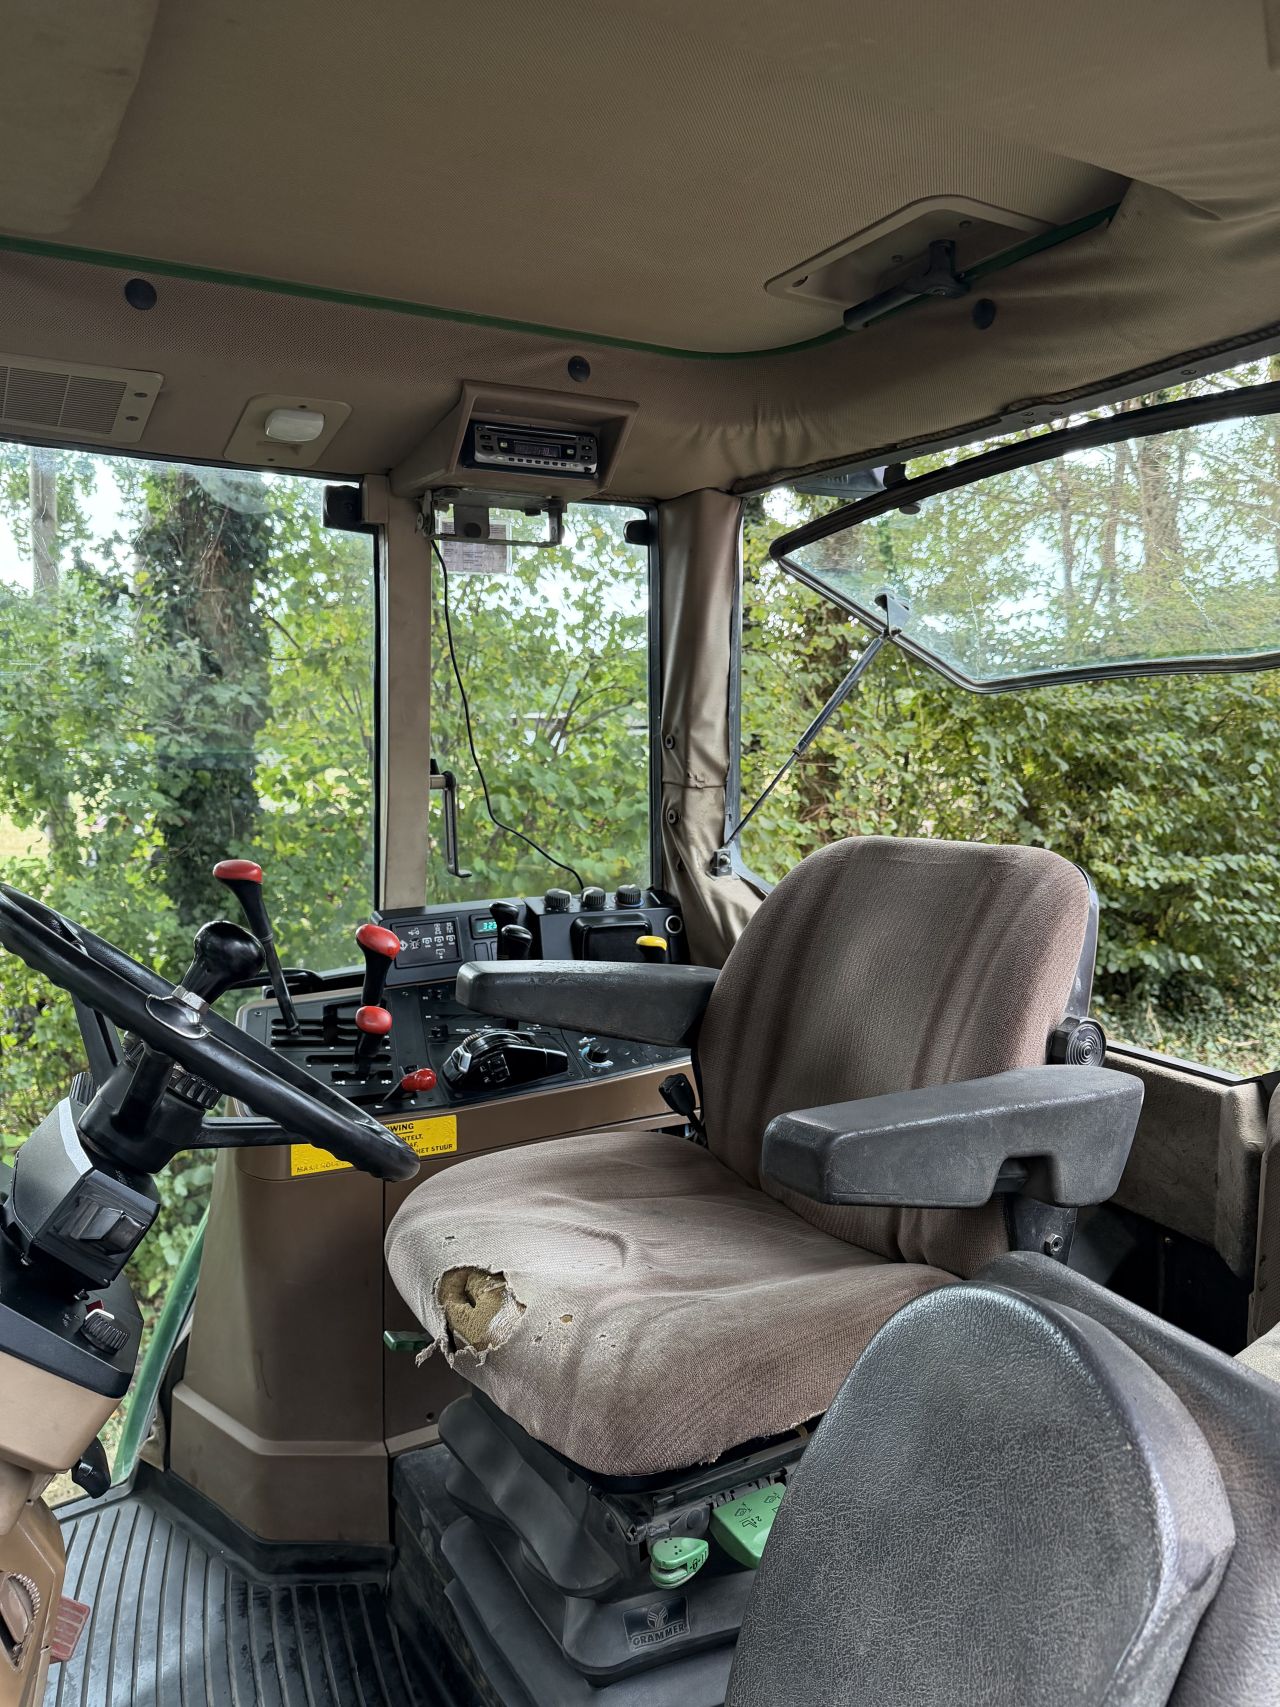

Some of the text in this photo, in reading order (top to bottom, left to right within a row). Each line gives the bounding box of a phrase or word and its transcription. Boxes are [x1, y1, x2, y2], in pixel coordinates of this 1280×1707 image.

[388, 1123, 414, 1131] WING
[431, 1143, 453, 1152] STUUR
[633, 1624, 684, 1646] GRAMMER
